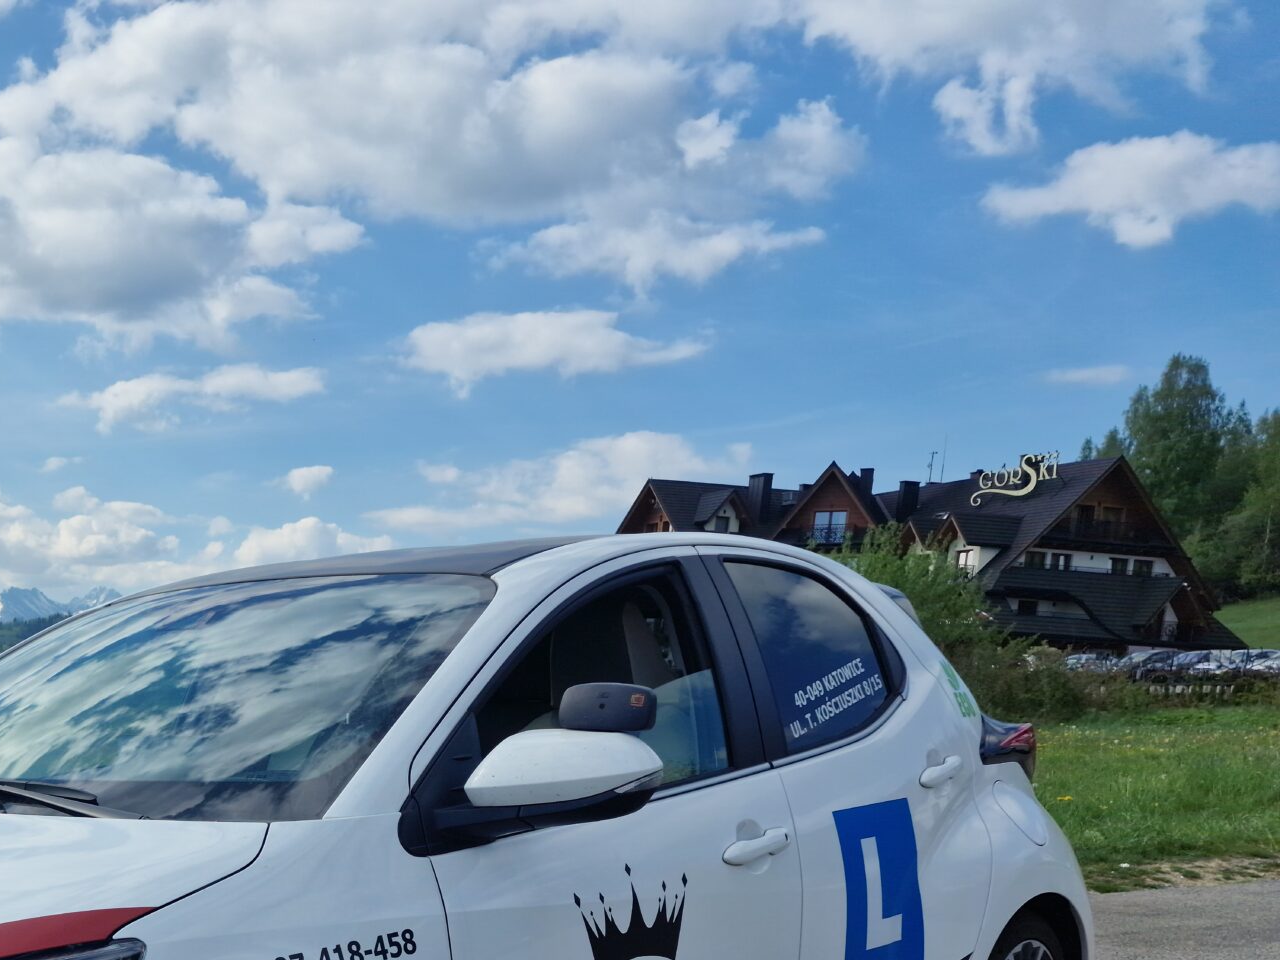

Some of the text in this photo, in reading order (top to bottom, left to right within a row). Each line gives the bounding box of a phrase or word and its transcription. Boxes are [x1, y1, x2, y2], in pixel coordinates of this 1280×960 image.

[789, 674, 883, 739] UL. T. KOŚCIUSZKI 8/15
[794, 657, 865, 708] 40-049 KATOWICE
[859, 836, 903, 951] L
